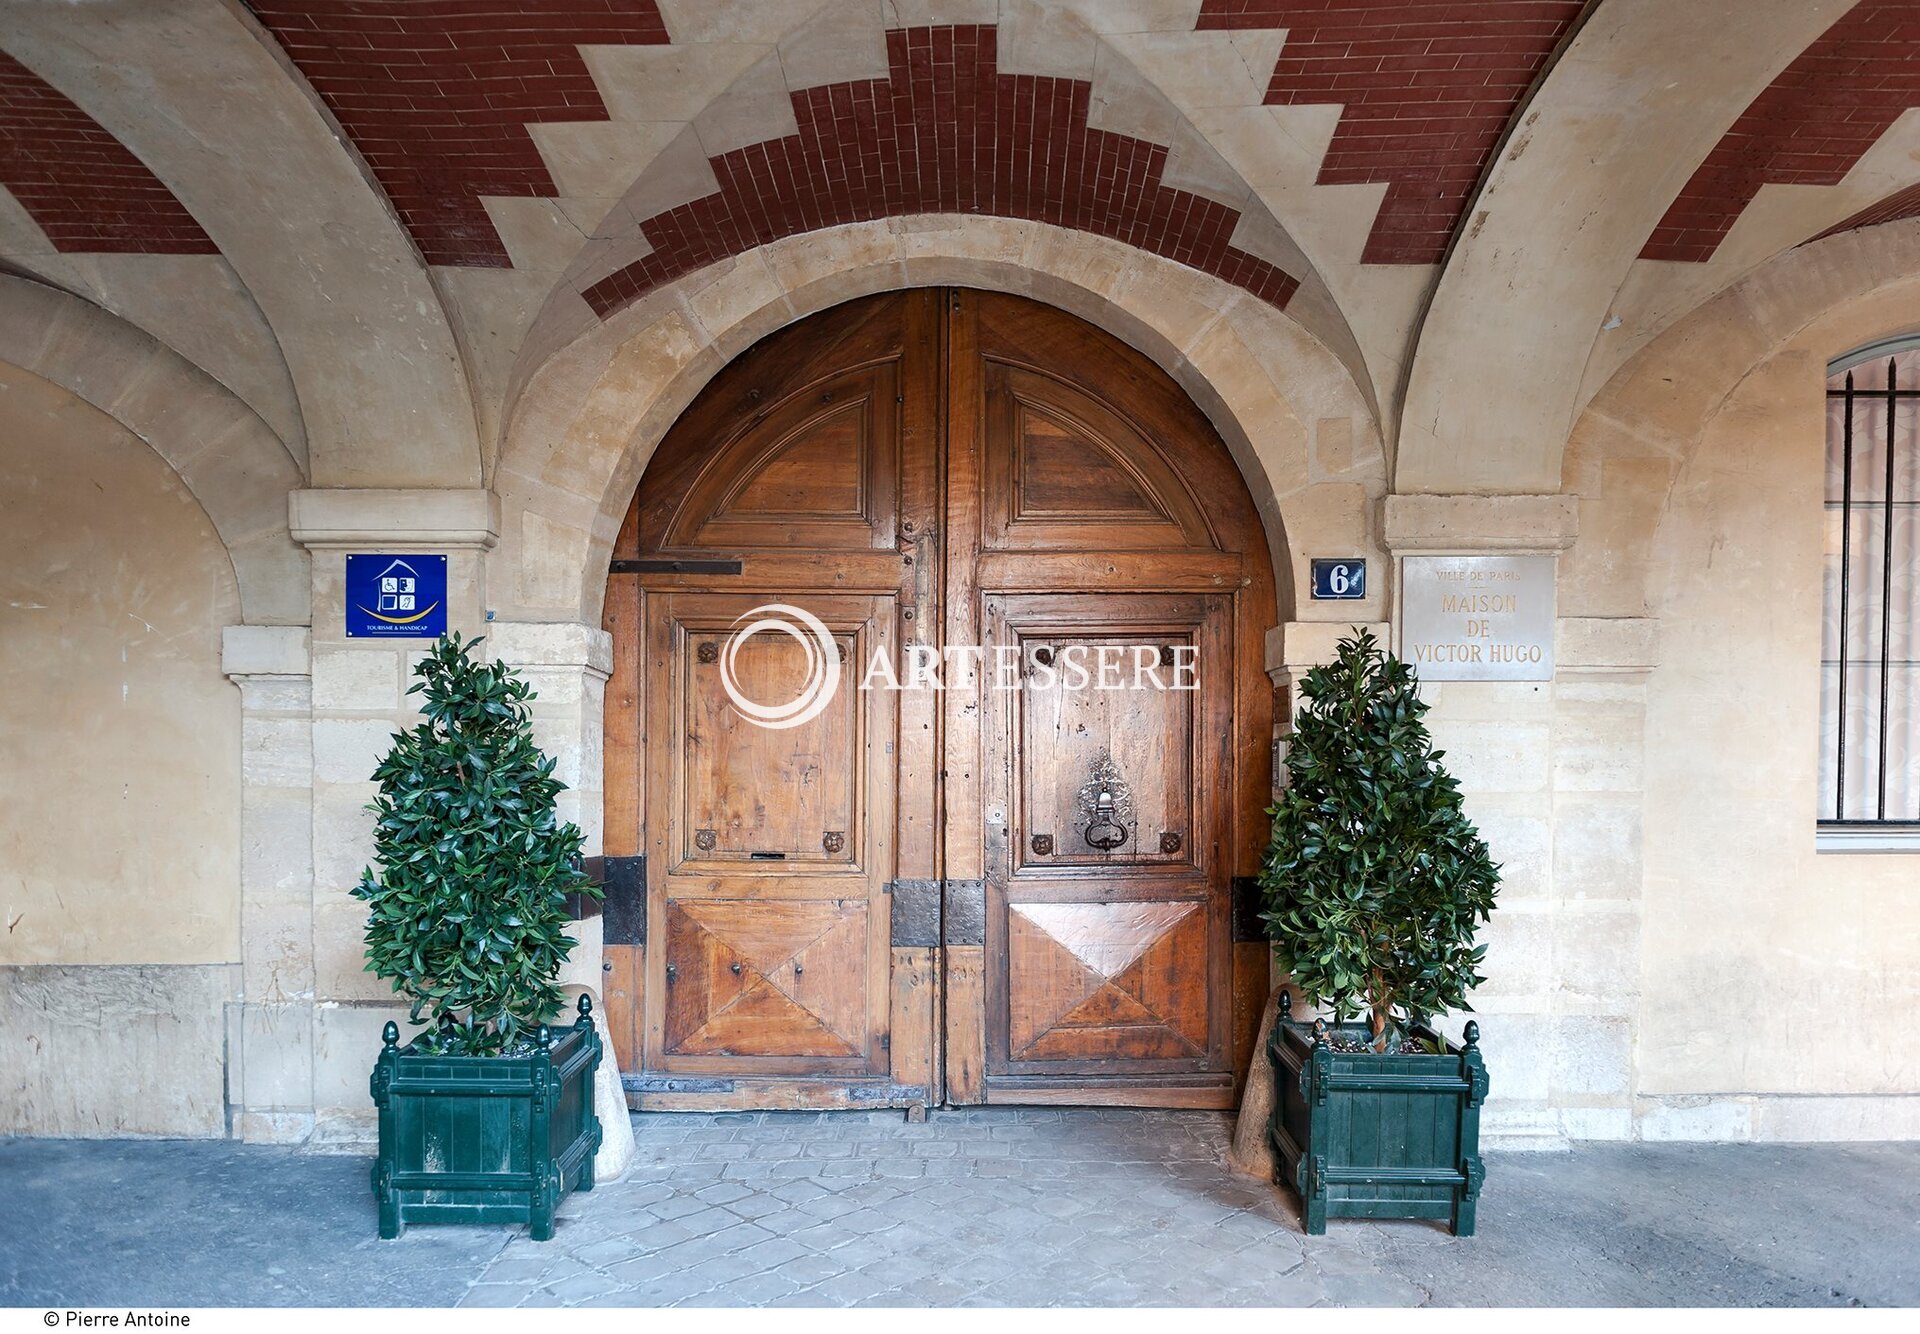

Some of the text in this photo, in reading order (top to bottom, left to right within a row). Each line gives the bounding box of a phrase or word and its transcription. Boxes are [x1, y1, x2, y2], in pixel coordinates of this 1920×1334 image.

[1330, 564, 1349, 594] 6
[1436, 571, 1521, 581] VILLE DE PARIS
[1442, 595, 1516, 613] MAISON
[1467, 620, 1490, 638] DE
[1414, 645, 1542, 663] VICTOR HUGO
